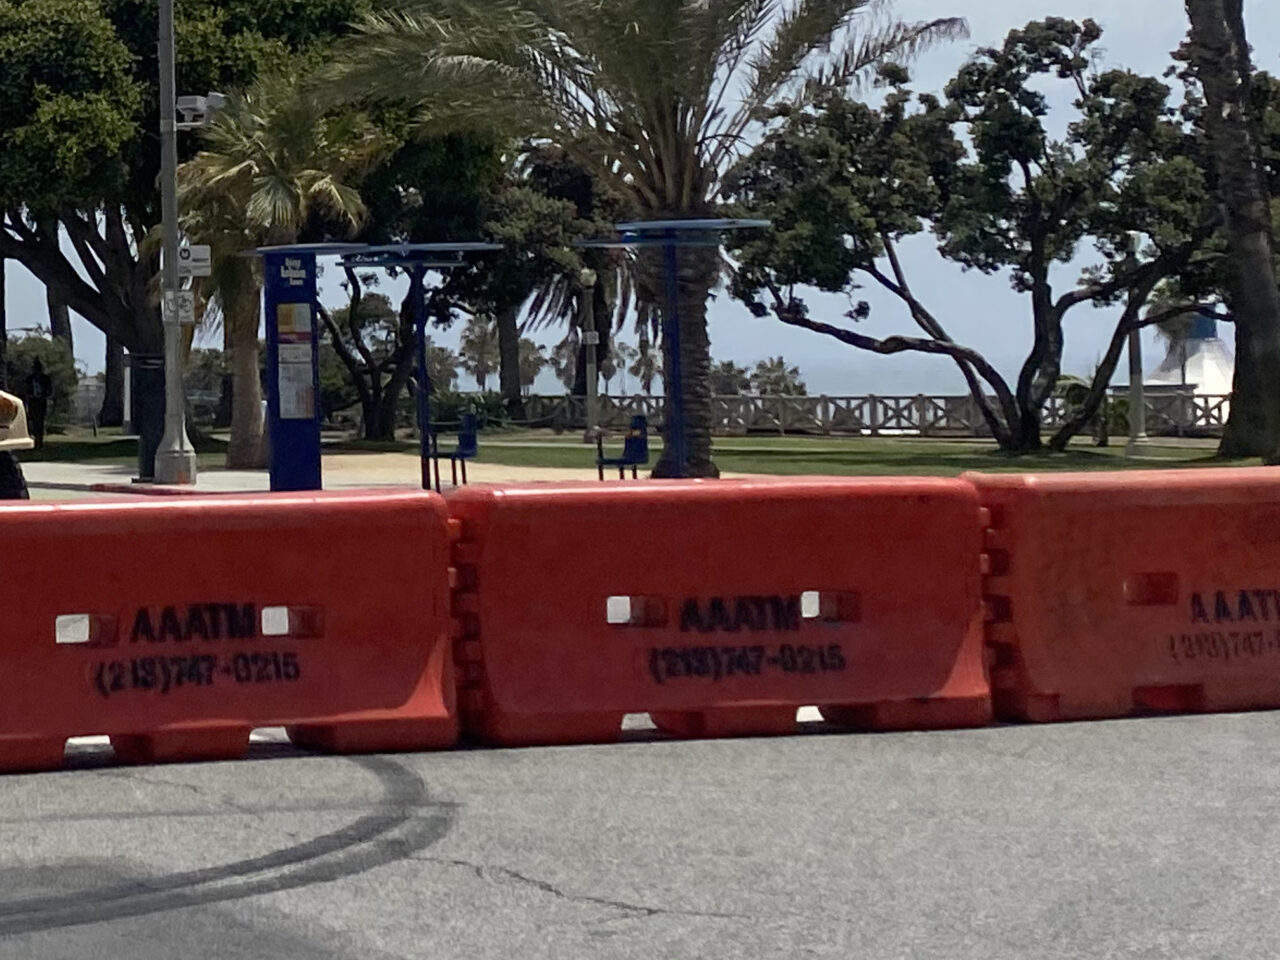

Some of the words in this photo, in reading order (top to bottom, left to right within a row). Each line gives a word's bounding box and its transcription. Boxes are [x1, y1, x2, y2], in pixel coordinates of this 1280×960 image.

[130, 602, 256, 643] AAATM
[679, 595, 800, 632] AAATM
[94, 651, 300, 698] (213)747-0215
